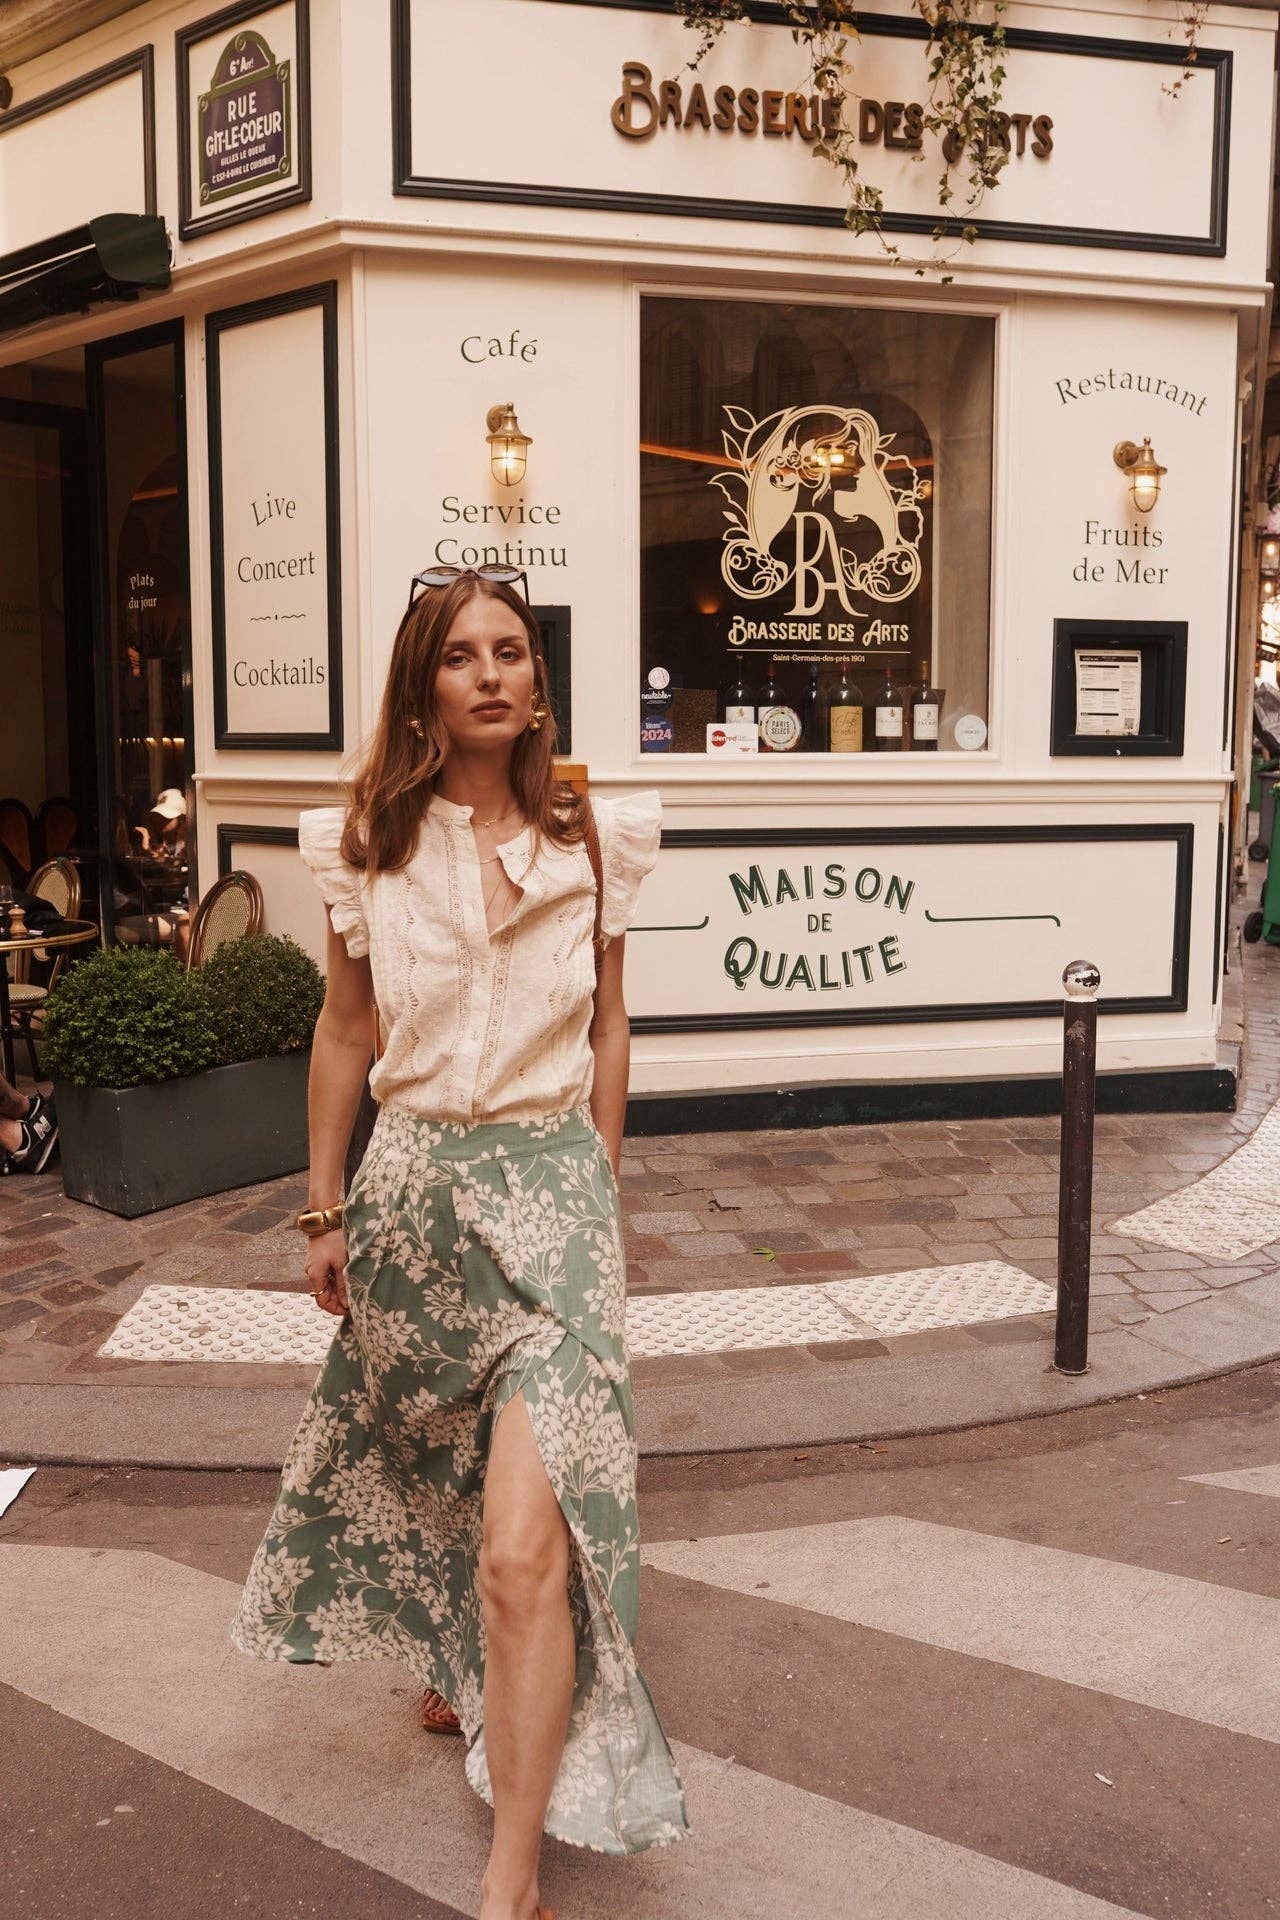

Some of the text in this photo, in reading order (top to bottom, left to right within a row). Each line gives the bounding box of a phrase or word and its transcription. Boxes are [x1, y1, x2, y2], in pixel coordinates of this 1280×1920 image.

[228, 91, 257, 122] RUE
[610, 61, 842, 140] BRASSERIE
[859, 98, 924, 149] DES
[221, 143, 266, 166] GILLES LE QUEUX
[243, 163, 250, 173] LE
[250, 154, 276, 170] CUISINIER
[460, 329, 538, 363] Café
[1055, 368, 1208, 416] Restaurant
[251, 493, 296, 527] Live
[442, 496, 561, 525] Service
[1085, 520, 1163, 548] Fruits
[237, 551, 315, 583] Concert
[434, 538, 568, 567] Continu
[1073, 557, 1169, 584] de Mer
[128, 596, 157, 613] du jour
[727, 615, 909, 647] BRASSERIE DES ARTS
[233, 657, 325, 687] Cocktails
[851, 655, 865, 663] 1901
[641, 728, 672, 741] 2024
[728, 863, 915, 915] MAISON
[807, 913, 832, 932] DE
